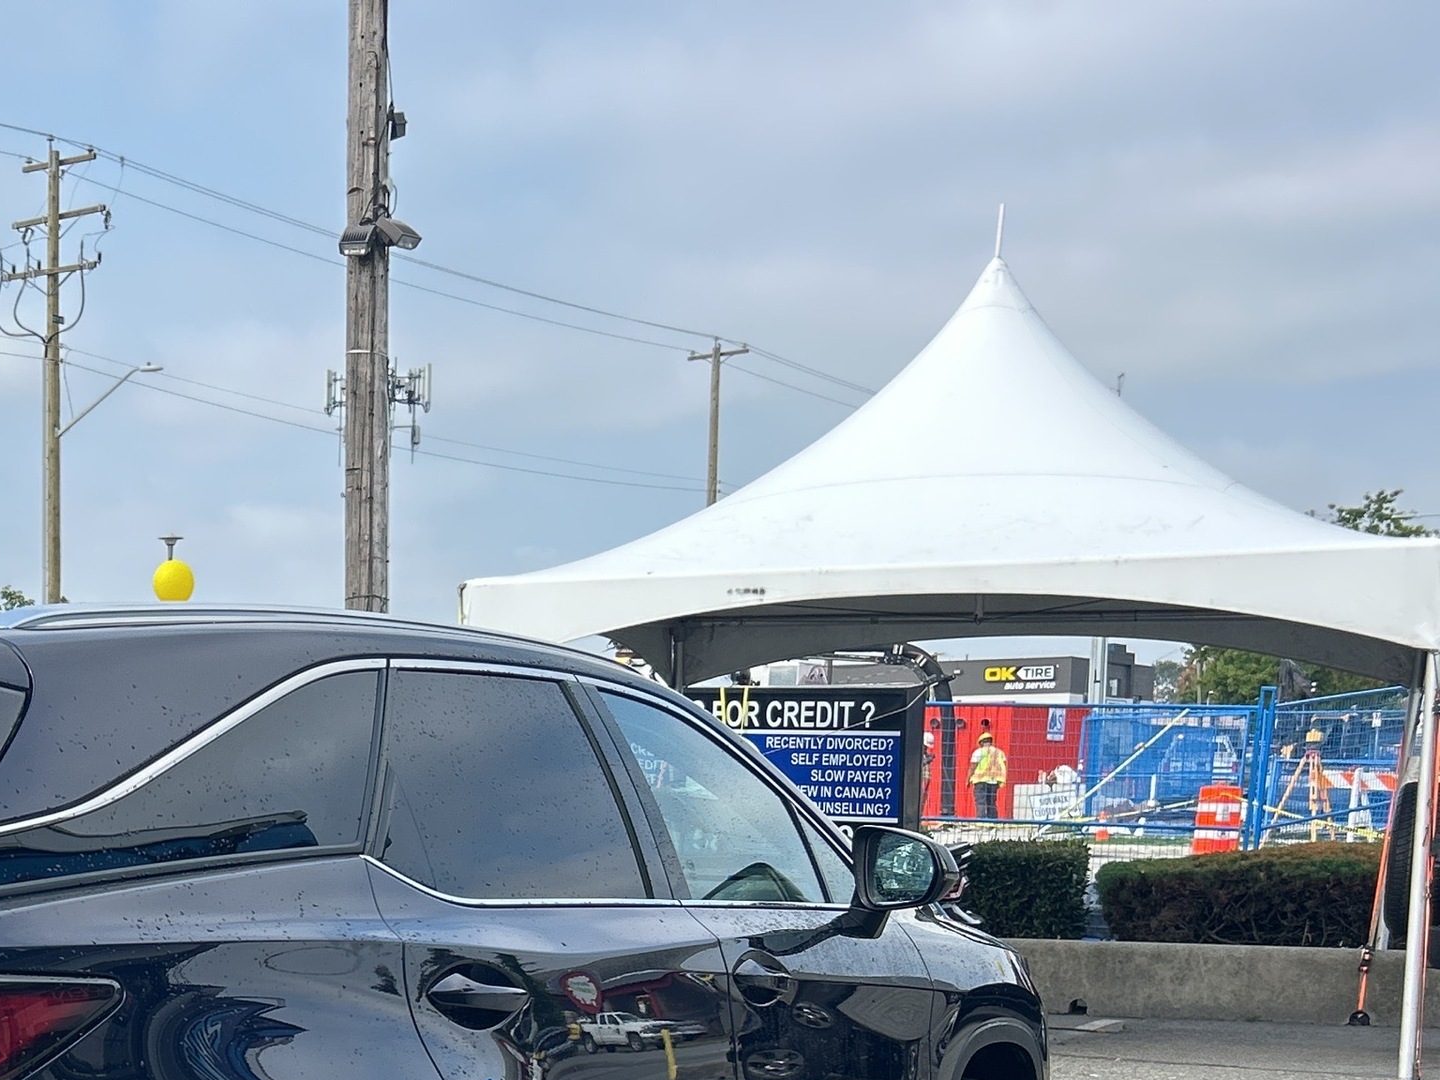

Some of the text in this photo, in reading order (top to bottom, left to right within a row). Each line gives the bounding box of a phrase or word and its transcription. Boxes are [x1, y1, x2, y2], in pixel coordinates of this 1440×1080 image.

[985, 667, 1052, 681] OK TIRE
[1004, 681, 1056, 690] auto service
[712, 700, 760, 728] FOR
[766, 700, 855, 729] CREDIT
[766, 736, 894, 751] RECENTLY DIVORCED?
[790, 753, 893, 767] SELF EMPLOYED?
[810, 769, 892, 784] SLOW PAYER?
[796, 785, 892, 800] EW IN CANADA?
[815, 801, 890, 816] UNSELLING?
